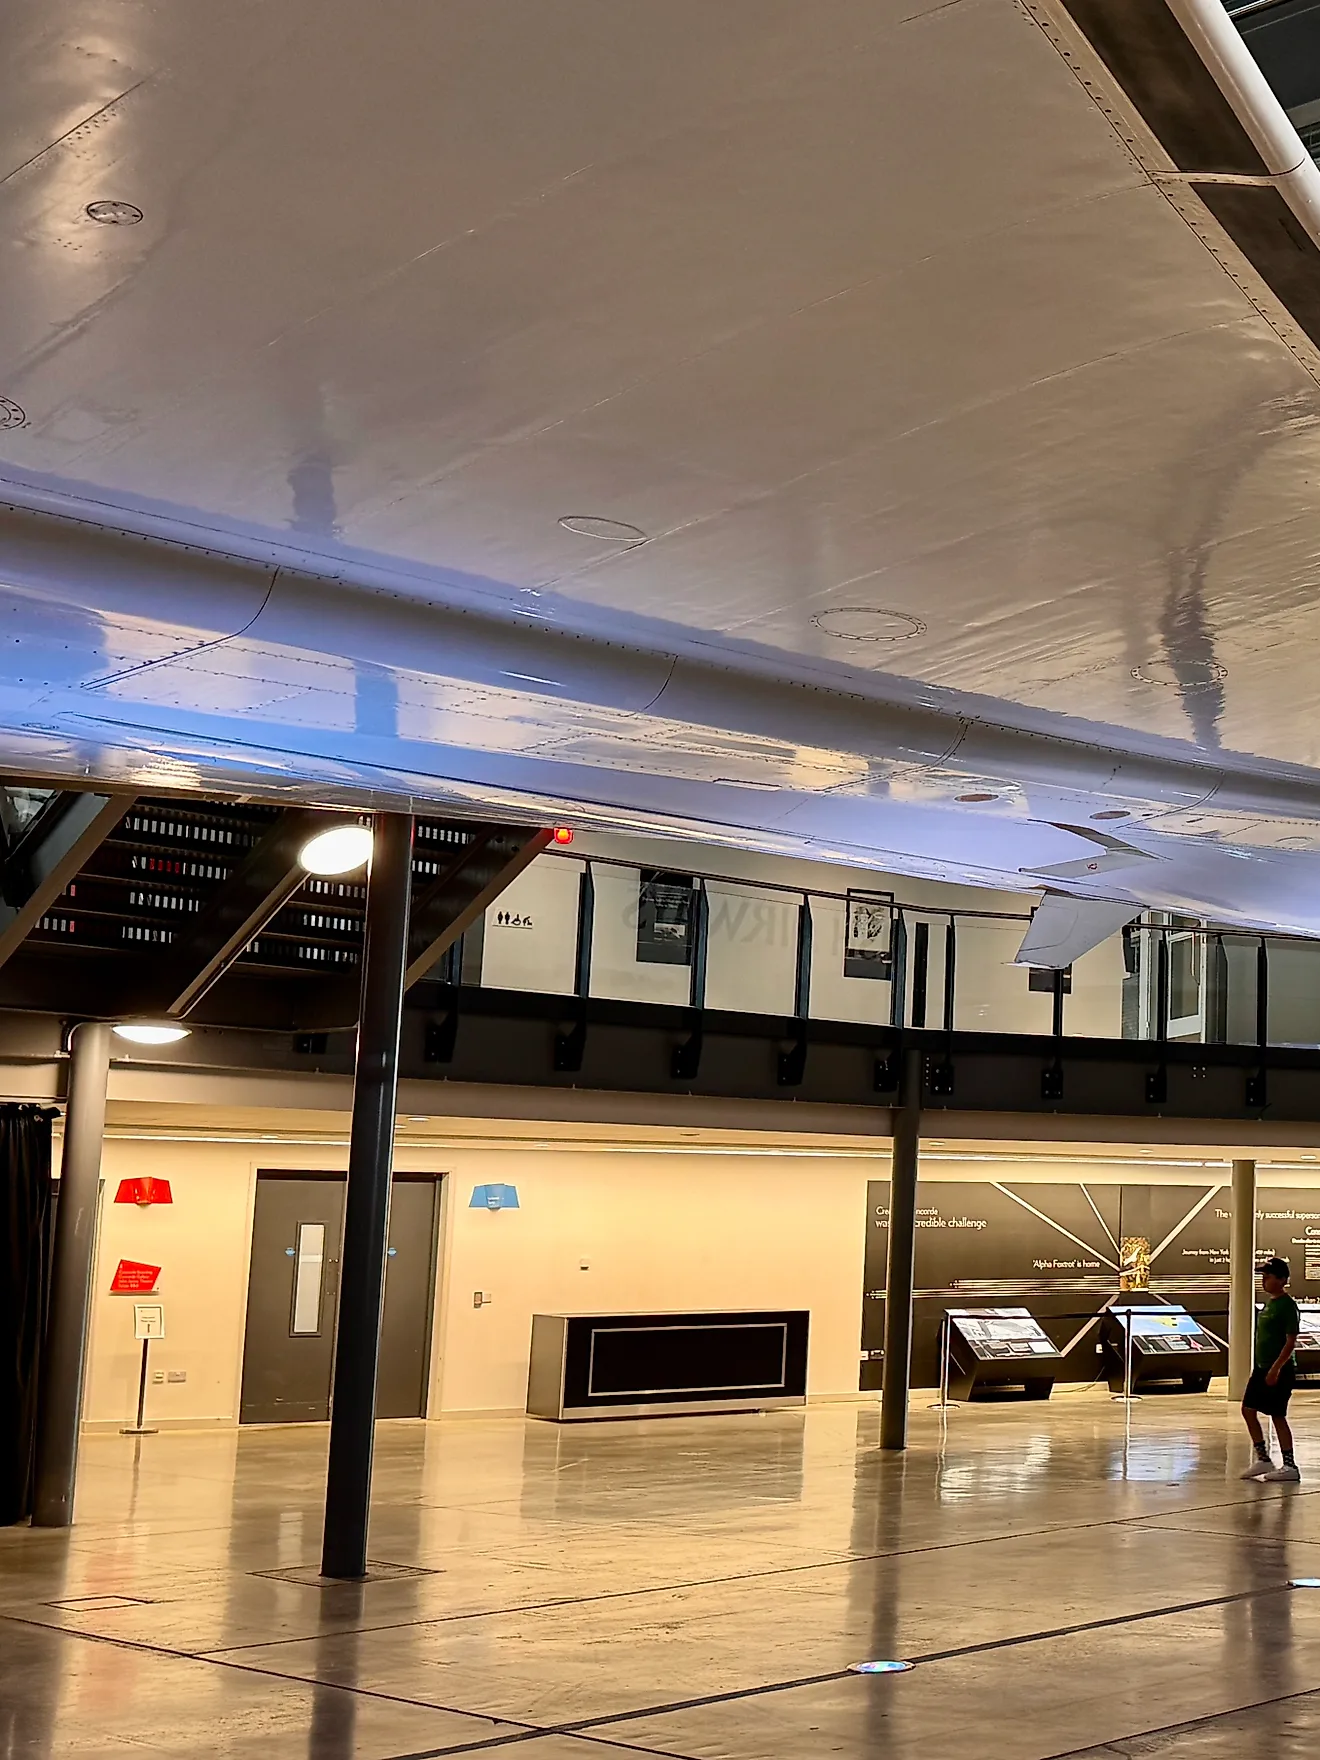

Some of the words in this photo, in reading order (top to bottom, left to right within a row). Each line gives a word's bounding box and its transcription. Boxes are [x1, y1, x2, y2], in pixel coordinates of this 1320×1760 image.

[915, 1206, 939, 1216] ncorde
[1214, 1208, 1227, 1218] The
[1254, 1209, 1264, 1220] nly
[948, 1216, 988, 1231] challenge
[1077, 1260, 1082, 1268] is
[1083, 1259, 1100, 1268] home
